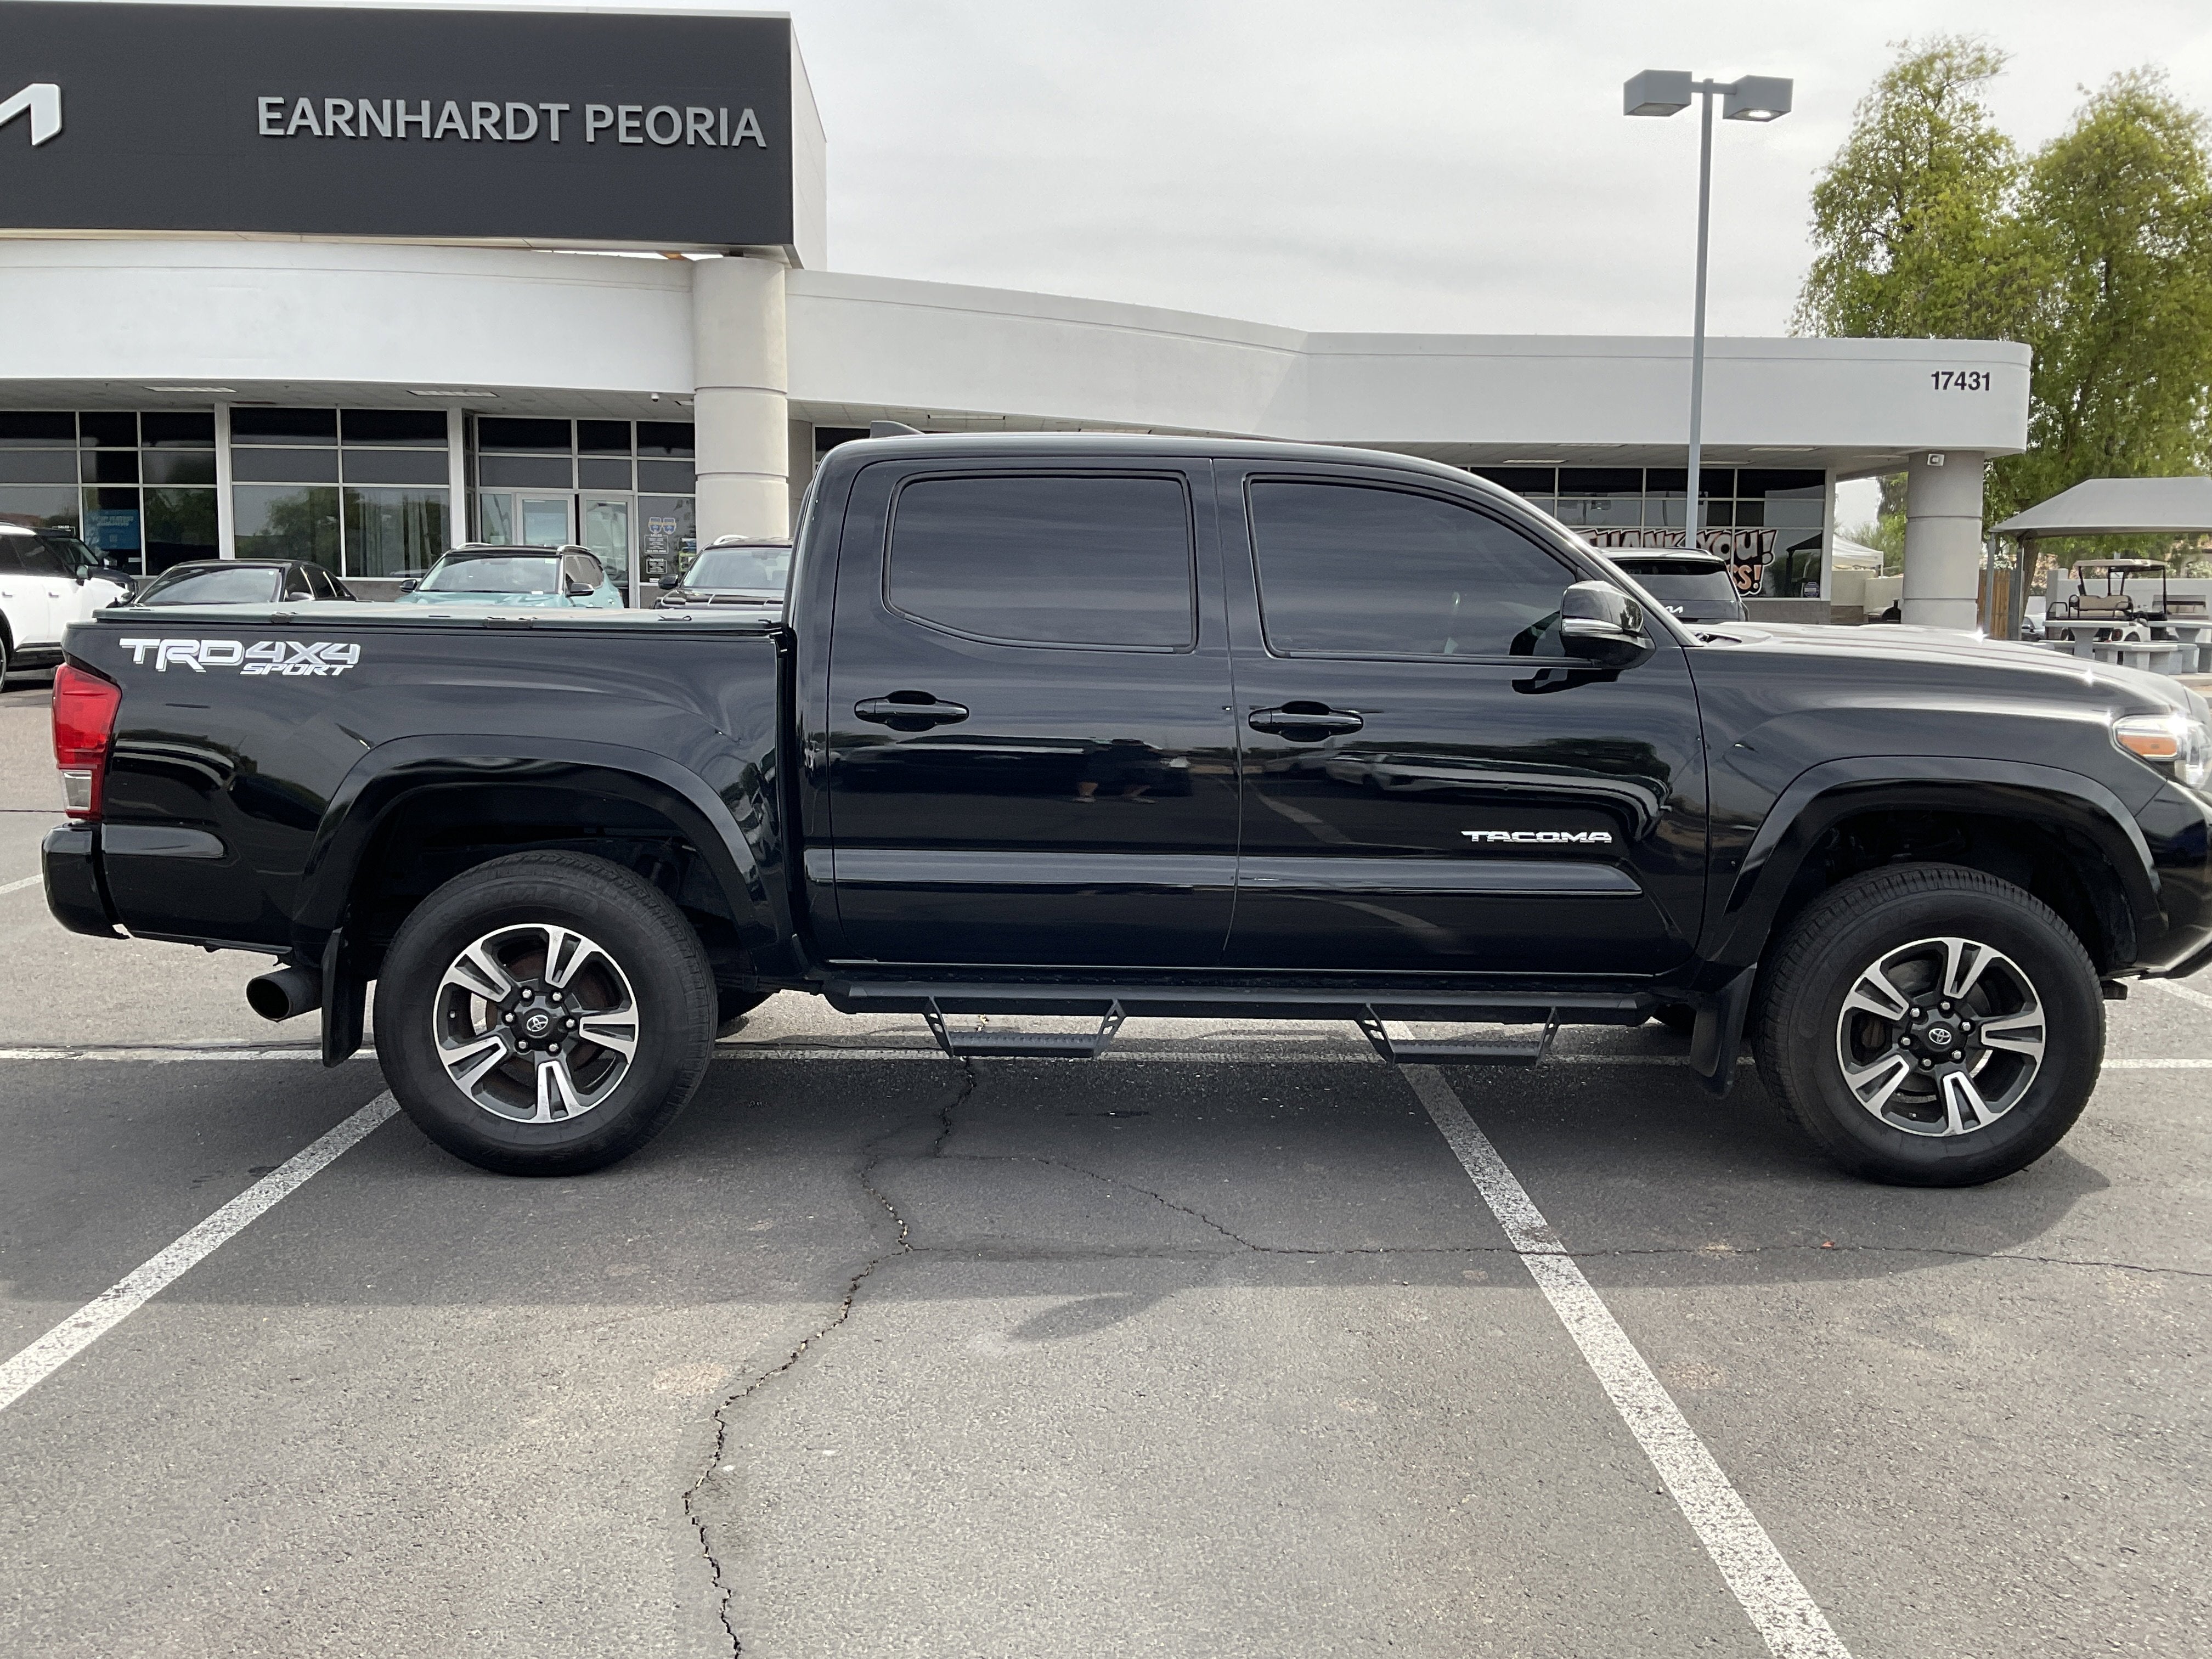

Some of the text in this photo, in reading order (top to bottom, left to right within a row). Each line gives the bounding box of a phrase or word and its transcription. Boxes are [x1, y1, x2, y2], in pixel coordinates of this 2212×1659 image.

[257, 96, 766, 148] EARNHARDT PEORIA
[1931, 371, 1990, 391] 17431
[119, 638, 245, 673] TRD
[240, 663, 354, 676] SPORT
[1461, 831, 1612, 843] TACOMA
